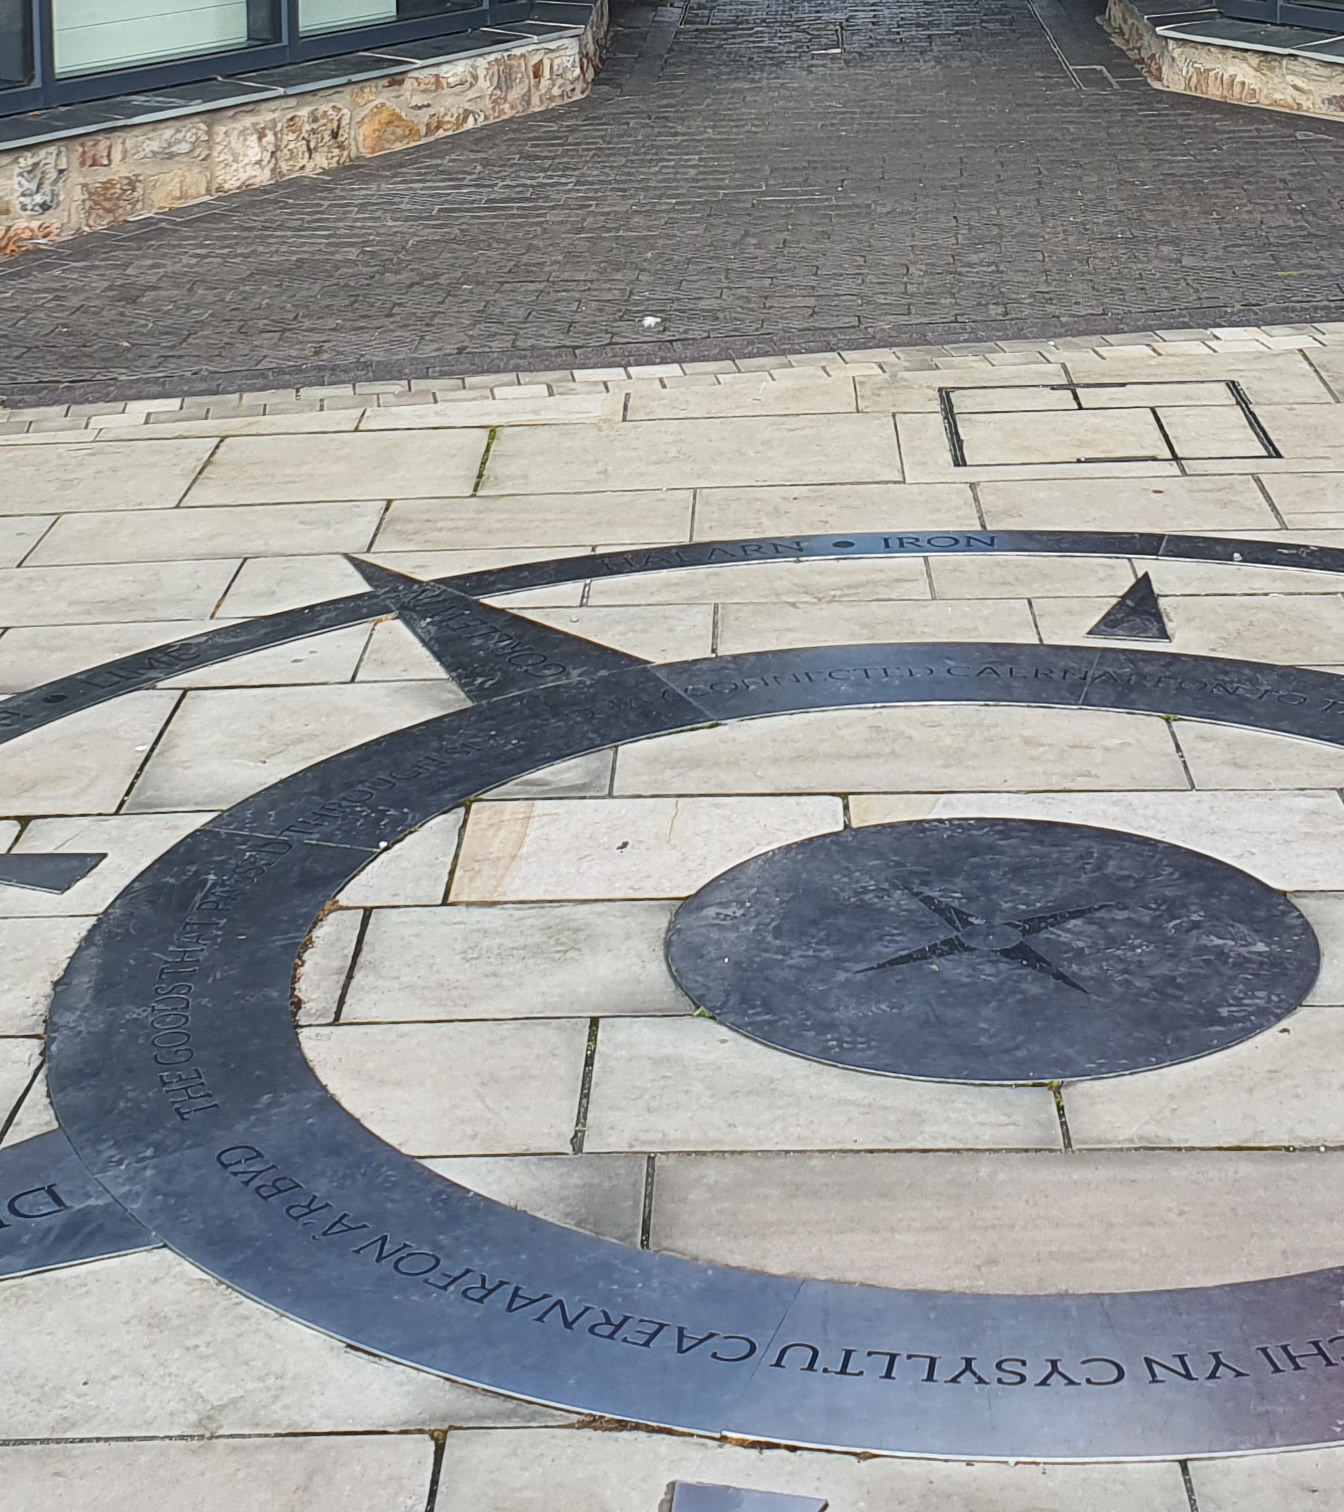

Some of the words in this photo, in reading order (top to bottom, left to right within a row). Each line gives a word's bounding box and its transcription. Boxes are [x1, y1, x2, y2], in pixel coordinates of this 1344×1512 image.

[882, 534, 998, 550] IRON
[81, 641, 202, 690] LIME
[158, 916, 228, 980] THAT
[150, 982, 195, 1066] GOODS
[158, 1067, 220, 1121] THE
[215, 1143, 306, 1202] BYD
[351, 1233, 758, 1363] CAERNARFON
[768, 1342, 1126, 1388] CYSYLLTU
[1143, 1350, 1251, 1384] YN
